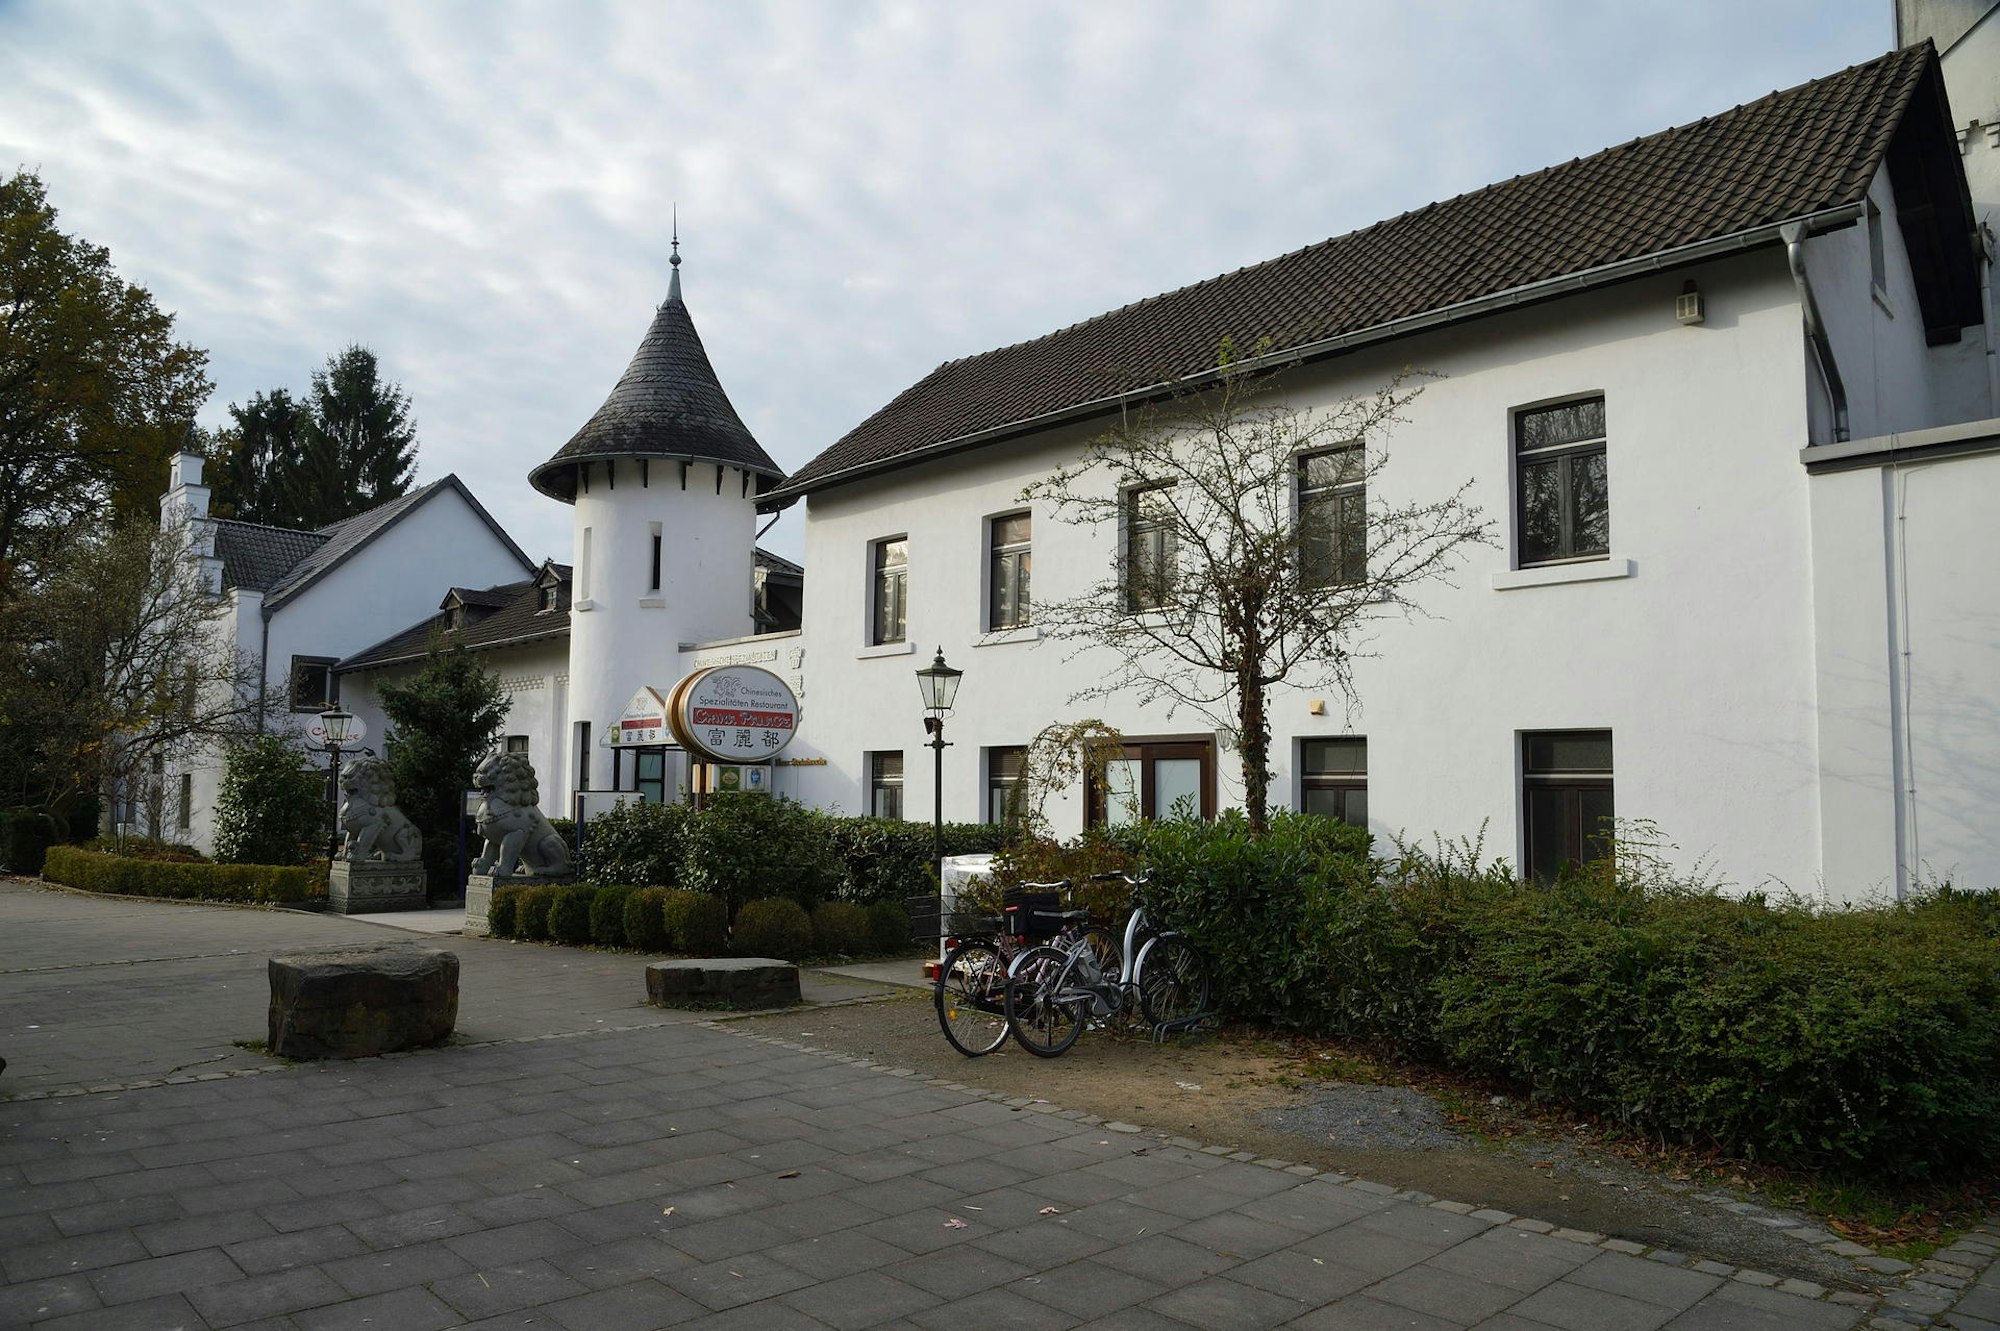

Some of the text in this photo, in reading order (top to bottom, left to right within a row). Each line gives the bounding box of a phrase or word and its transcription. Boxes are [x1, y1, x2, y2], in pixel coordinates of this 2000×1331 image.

[741, 686, 782, 698] Chinesisches
[700, 696, 788, 710] Spezialitäten Restaurant
[708, 728, 779, 749] 富麗都
